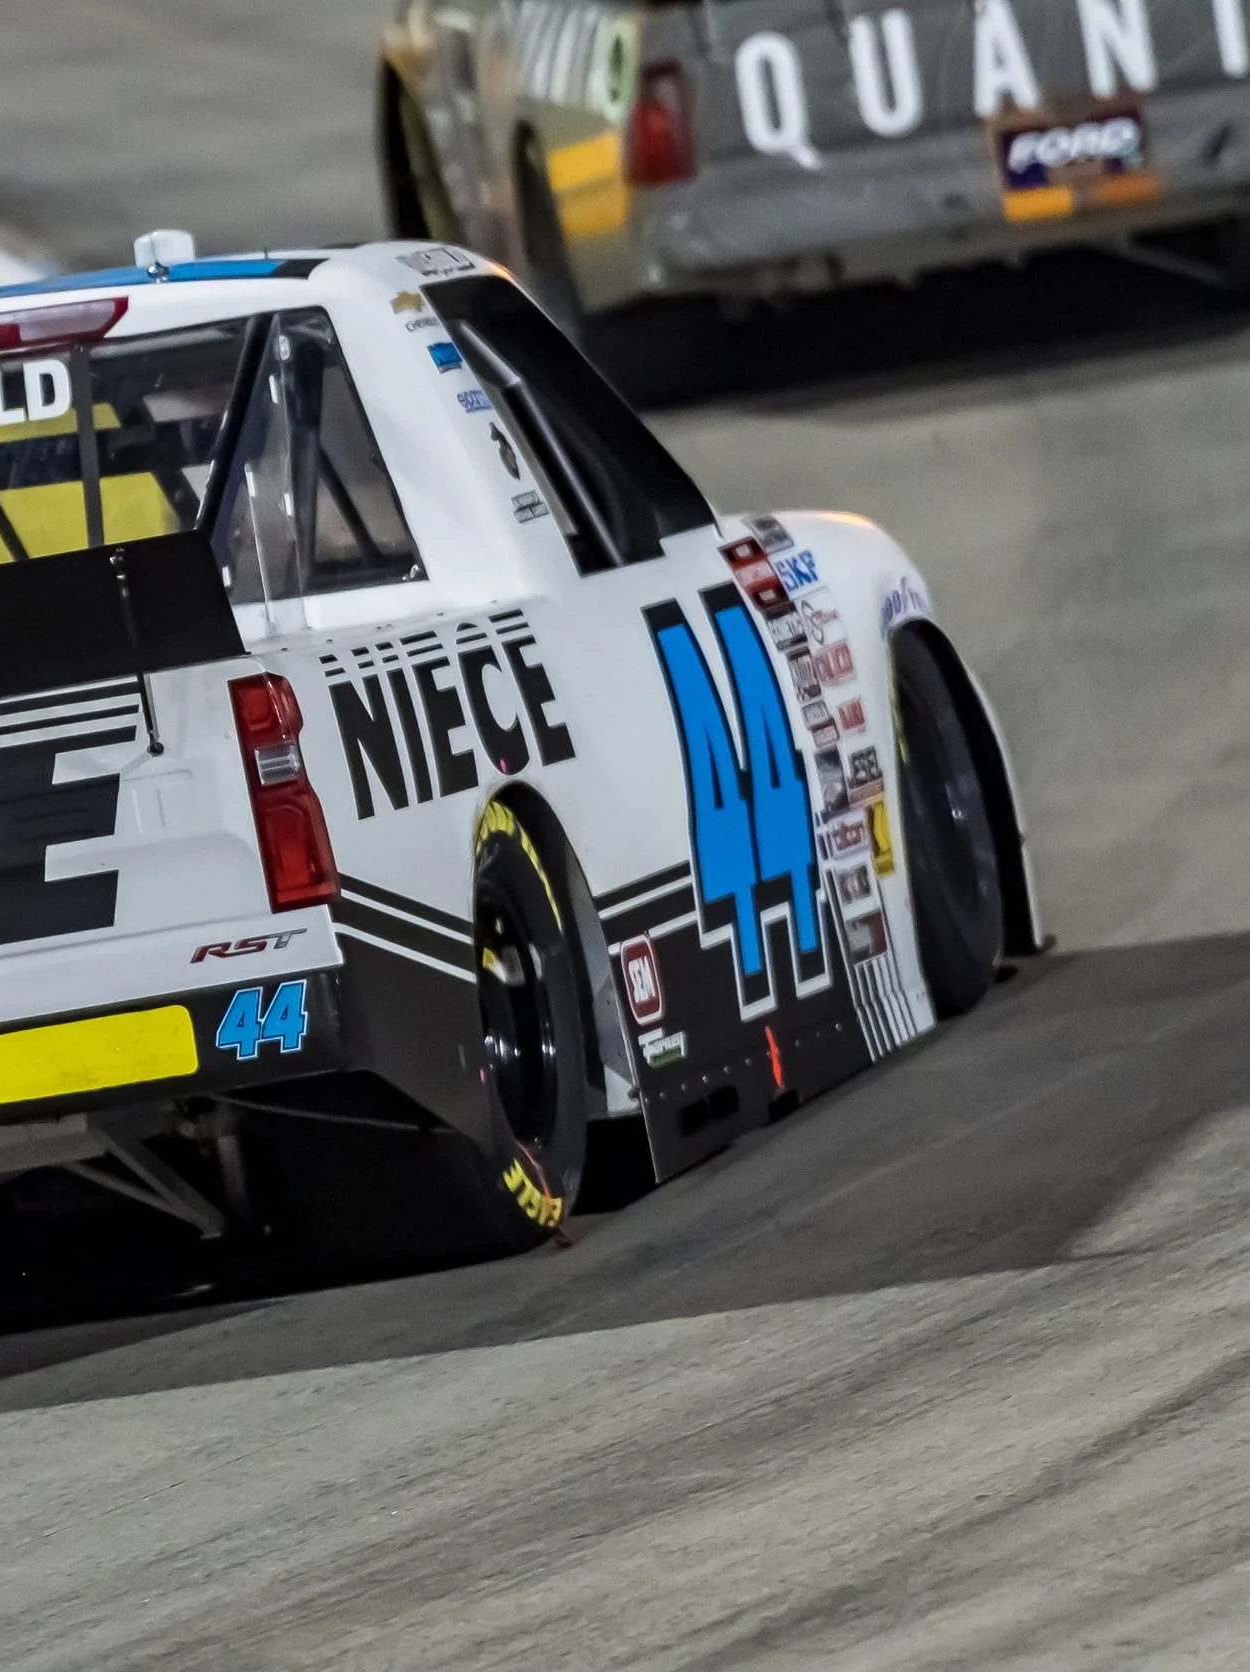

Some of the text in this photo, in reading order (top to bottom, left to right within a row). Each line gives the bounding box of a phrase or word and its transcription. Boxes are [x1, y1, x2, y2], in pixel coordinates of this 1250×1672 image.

[773, 549, 819, 593] SKF
[319, 608, 576, 821] NIECE
[640, 580, 833, 1021] 44
[190, 928, 307, 963] RST
[216, 979, 308, 1060] 44
